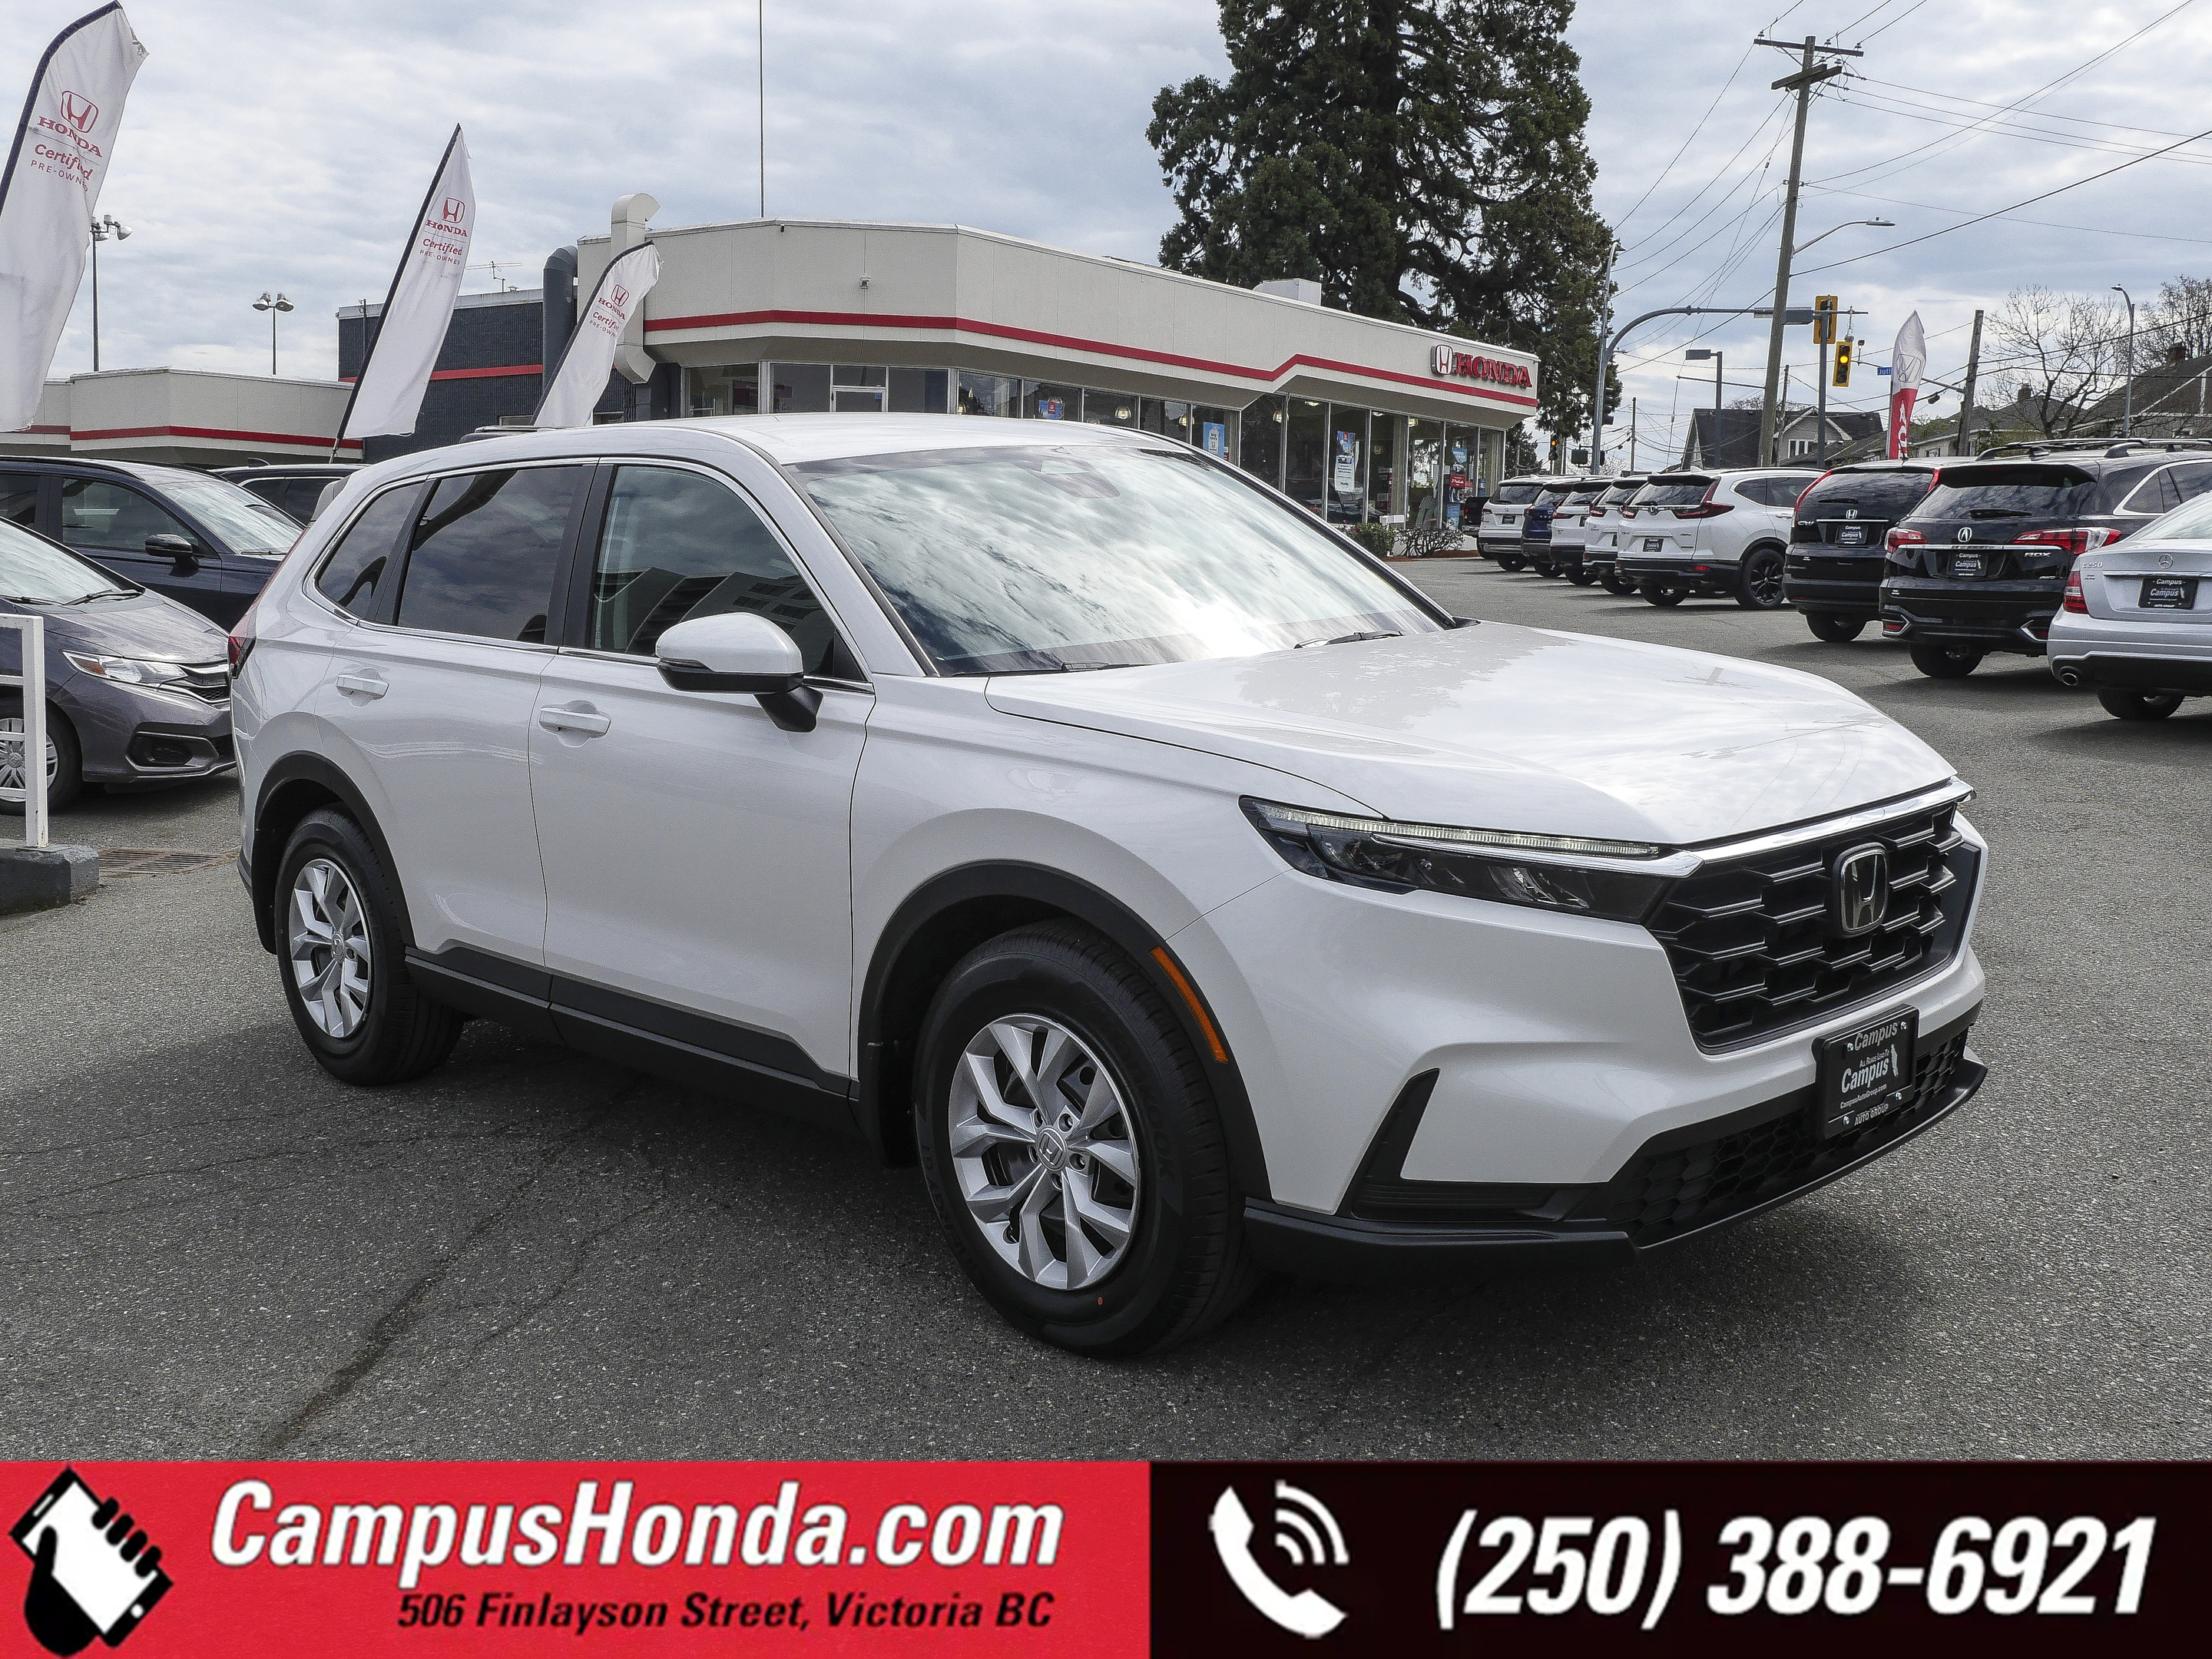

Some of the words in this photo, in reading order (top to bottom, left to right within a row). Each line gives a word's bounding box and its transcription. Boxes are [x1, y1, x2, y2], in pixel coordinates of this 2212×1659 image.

[37, 116, 103, 158] HONDA
[426, 220, 469, 237] HONDA
[422, 238, 463, 256] Certified
[598, 297, 626, 320] HONDA
[1454, 352, 1533, 388] HONDA
[2150, 588, 2180, 598] Campus
[1854, 1022, 1898, 1051] Campus
[1841, 1058, 1889, 1093] Campus
[1840, 1083, 1887, 1109] CampusAutoGroup.com
[1854, 1111, 1869, 1126] AUTO
[1870, 1103, 1889, 1118] GROUP
